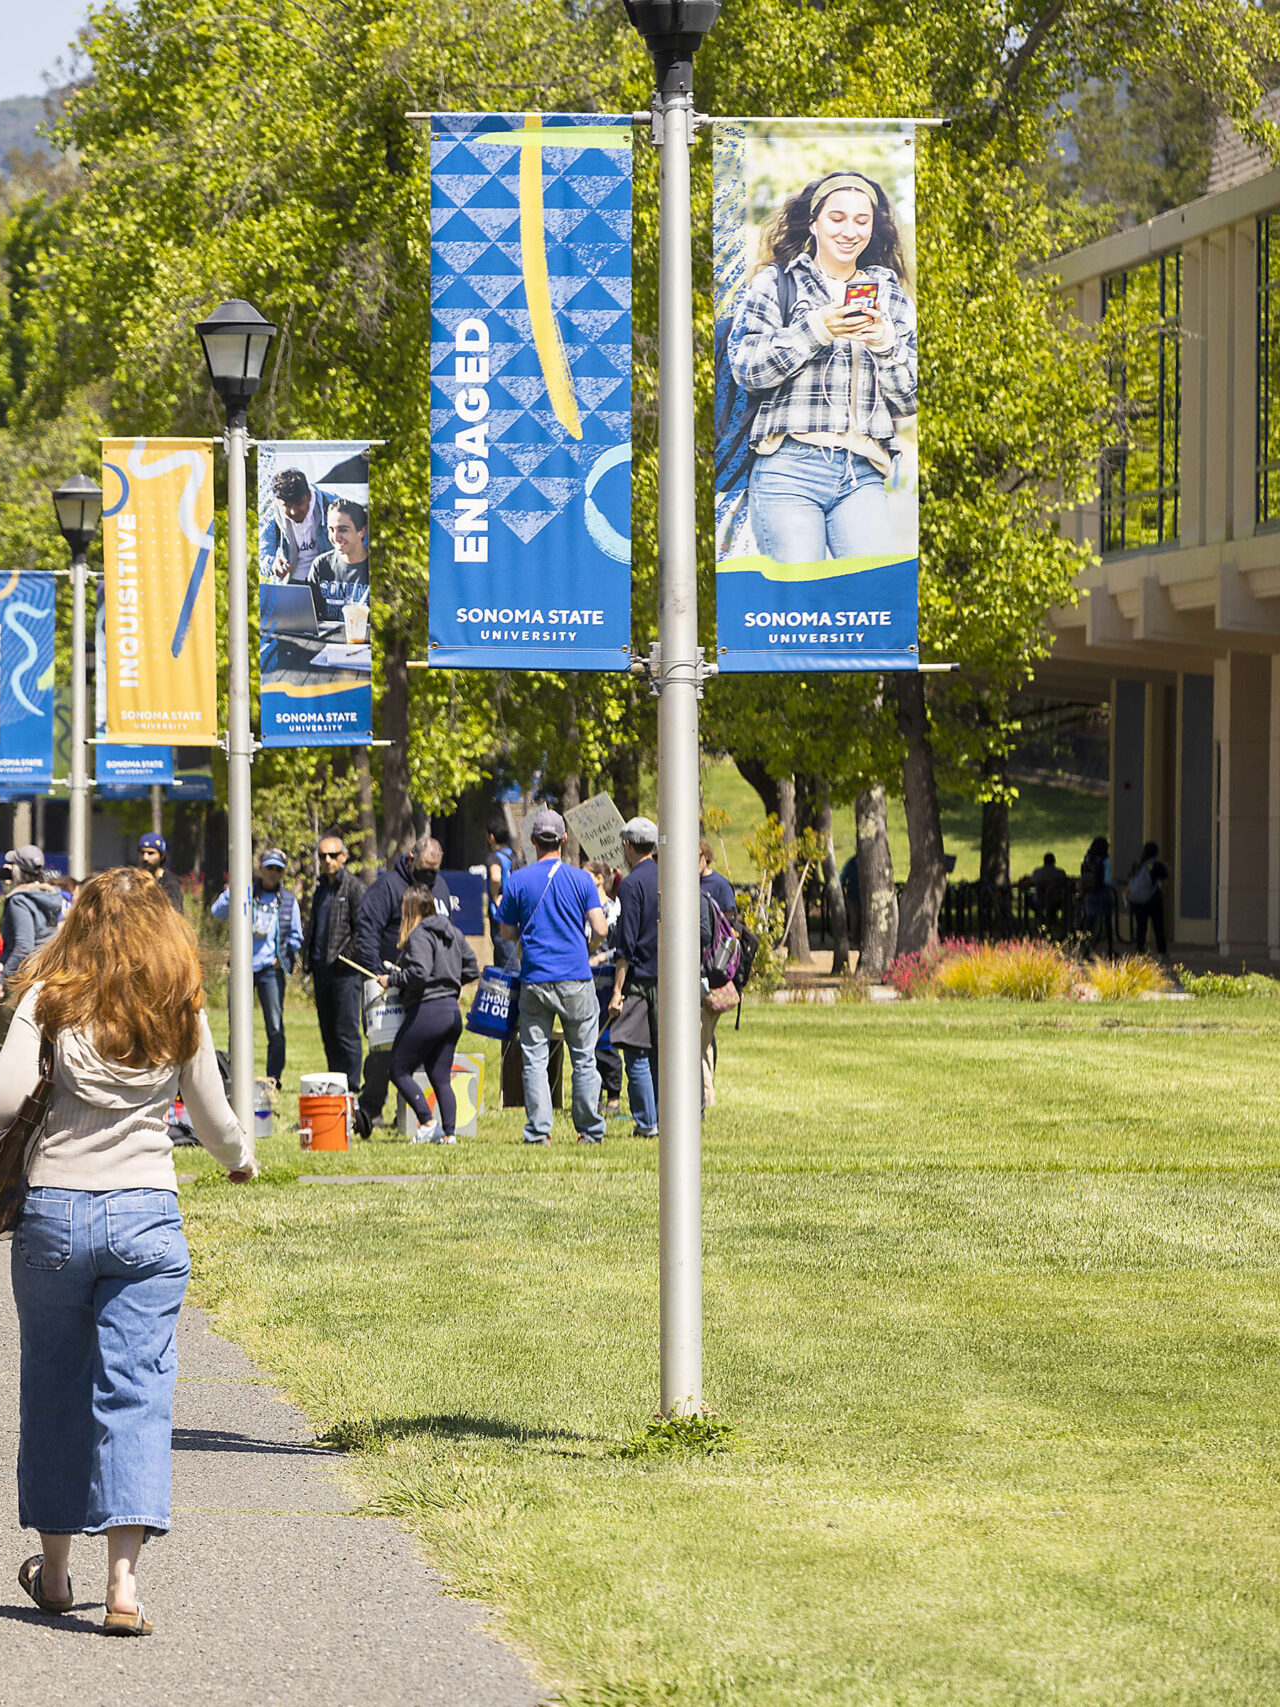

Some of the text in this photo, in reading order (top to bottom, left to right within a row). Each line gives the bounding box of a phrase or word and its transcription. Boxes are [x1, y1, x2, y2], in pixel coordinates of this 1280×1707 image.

[454, 317, 490, 563] ENGAGED
[118, 513, 140, 688] INQUISITIVE
[456, 607, 605, 625] SONOMA STATE
[744, 611, 892, 627] SONOMA STATE
[480, 630, 578, 642] UNIVERSITY
[768, 632, 865, 644] UNIVERSITY
[121, 710, 203, 721] SONOMA STATE
[275, 712, 358, 724] SONOMA STATE
[134, 722, 188, 730] UNIVERSITY
[288, 724, 343, 732] UNIVERSITY
[478, 1001, 509, 1019] DO IT
